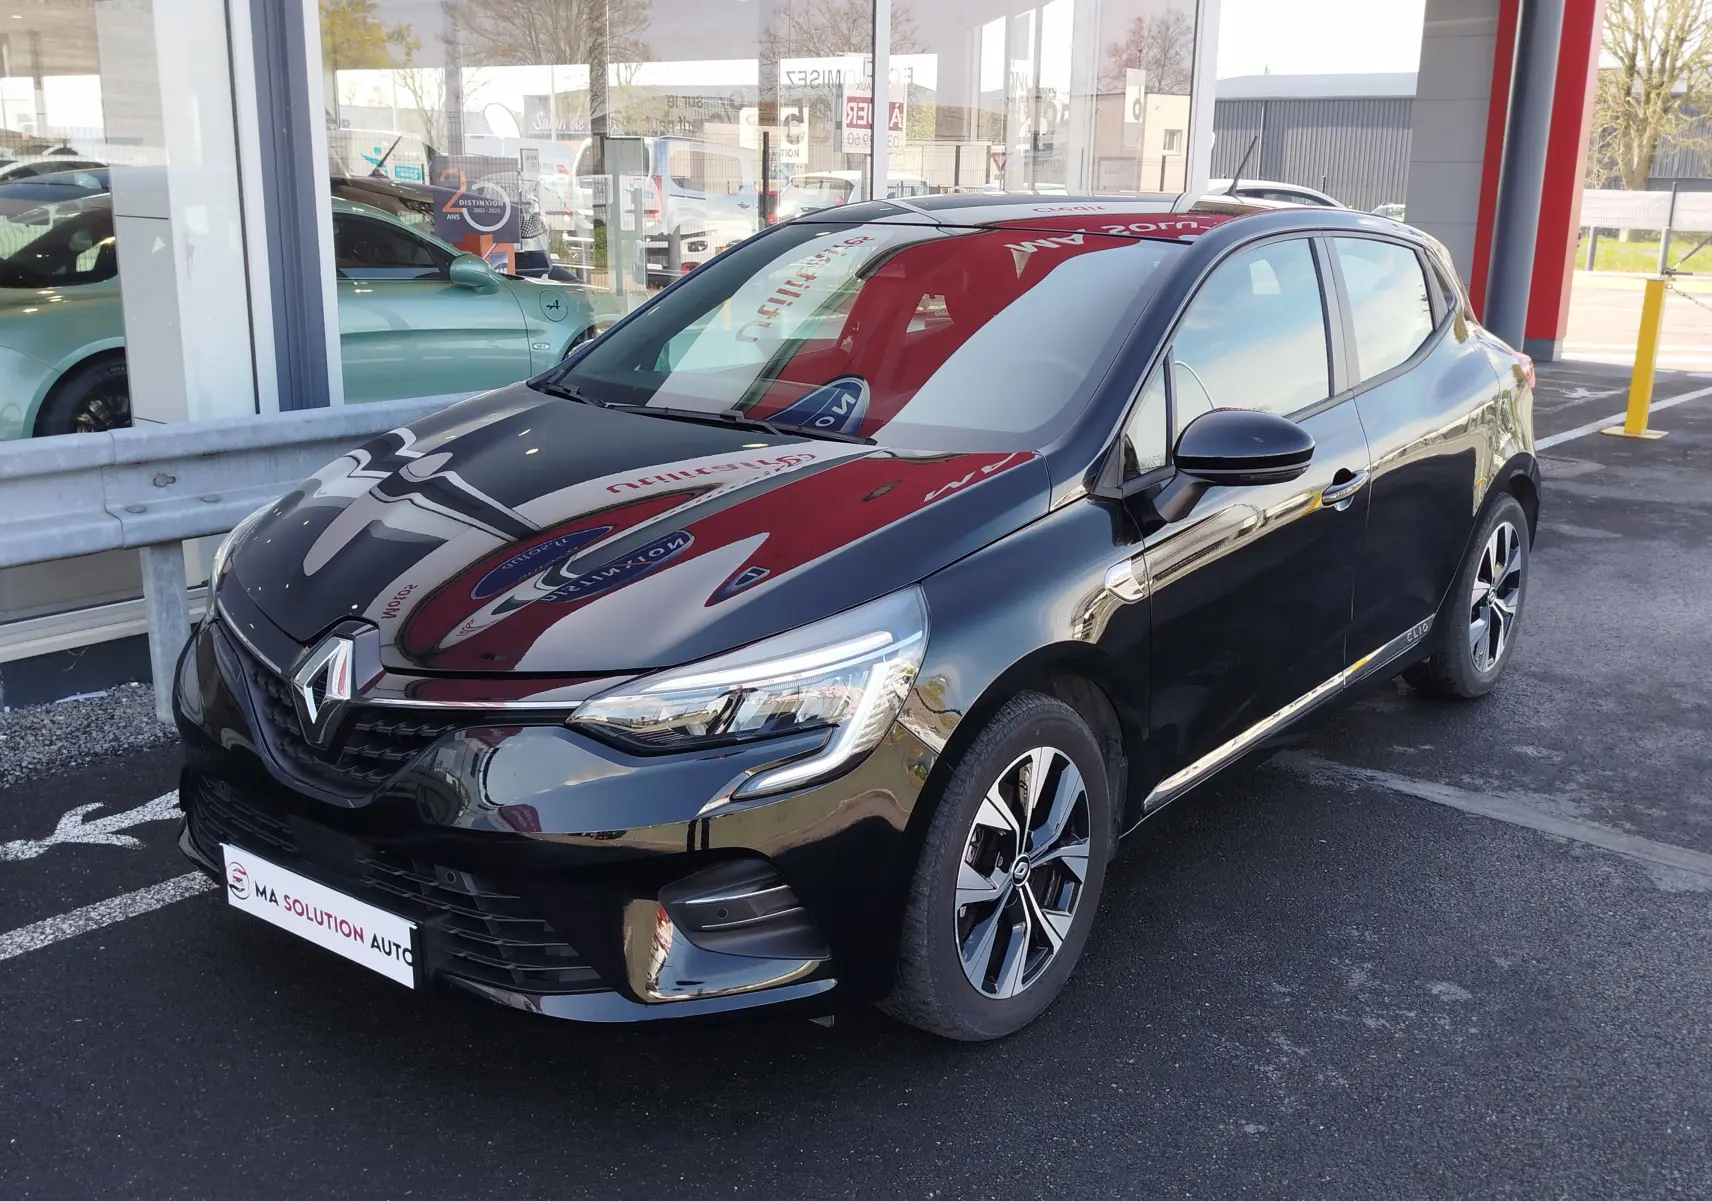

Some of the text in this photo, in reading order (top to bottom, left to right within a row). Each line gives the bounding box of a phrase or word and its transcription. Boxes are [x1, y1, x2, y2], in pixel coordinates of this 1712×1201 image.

[532, 110, 567, 130] San
[459, 199, 504, 207] DISTINXION
[1406, 622, 1429, 642] CLIO
[254, 881, 414, 967] MA SOLUTION AUTO
